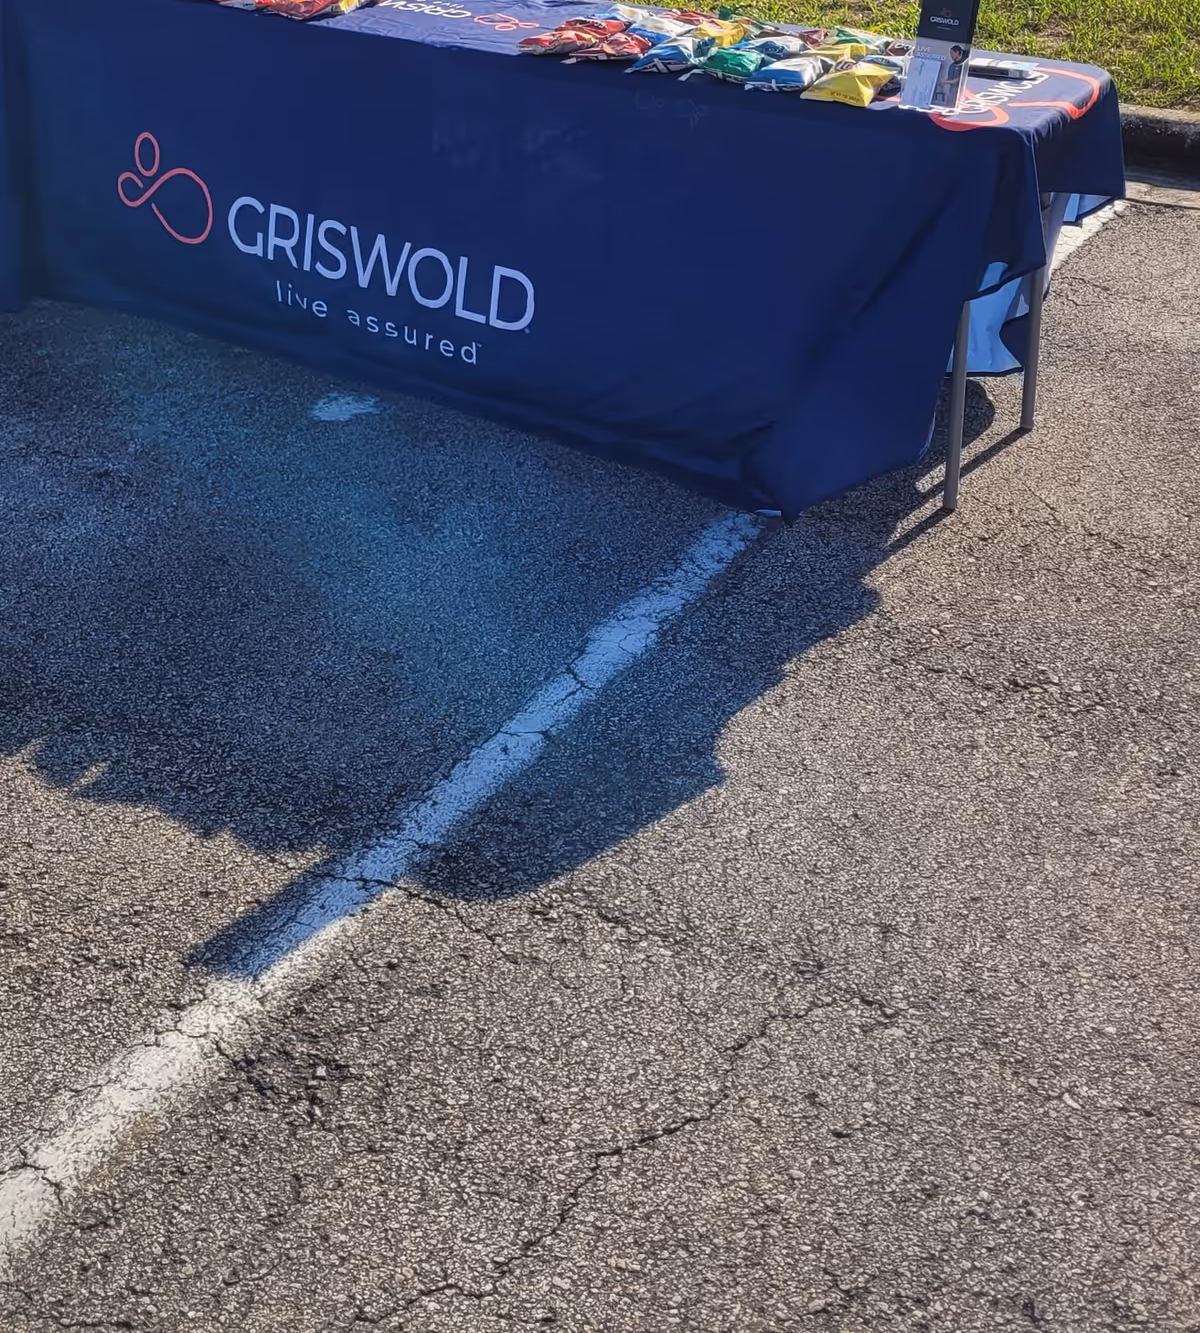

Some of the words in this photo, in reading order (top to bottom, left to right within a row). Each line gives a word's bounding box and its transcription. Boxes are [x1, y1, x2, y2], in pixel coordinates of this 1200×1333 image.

[377, 0, 473, 19] GRISW
[929, 16, 960, 26] GRISWOLD
[227, 196, 535, 332] GRISWOLD
[276, 280, 328, 318] live
[347, 308, 478, 366] assured
